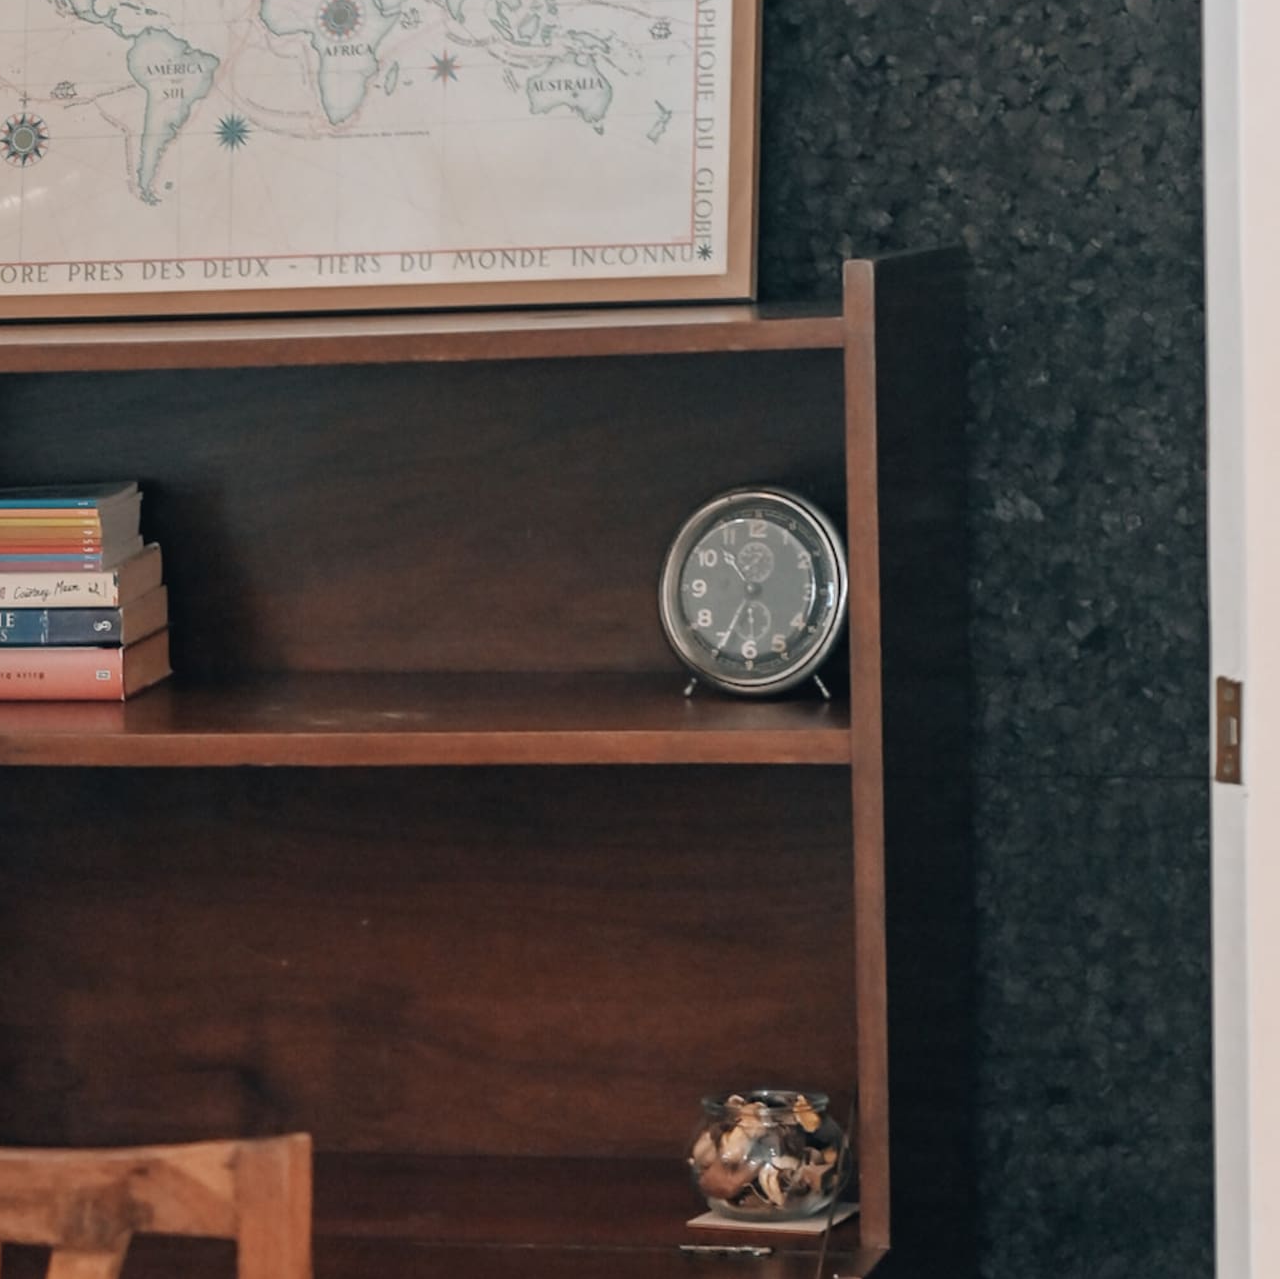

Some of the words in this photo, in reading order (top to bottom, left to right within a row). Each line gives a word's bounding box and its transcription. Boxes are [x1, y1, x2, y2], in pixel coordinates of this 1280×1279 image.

[696, 116, 715, 150] DU
[142, 260, 186, 280] DES
[204, 257, 270, 278] DEUX
[317, 254, 381, 275] TIERS
[400, 252, 433, 272] DU
[452, 249, 550, 270] MONDE
[572, 244, 694, 267] INCONNU
[699, 549, 718, 567] 10
[798, 552, 811, 569] 2
[692, 580, 707, 598] 9
[697, 609, 712, 627] 8
[790, 612, 806, 631] 4
[741, 640, 757, 659] 6
[772, 634, 786, 652] 5
